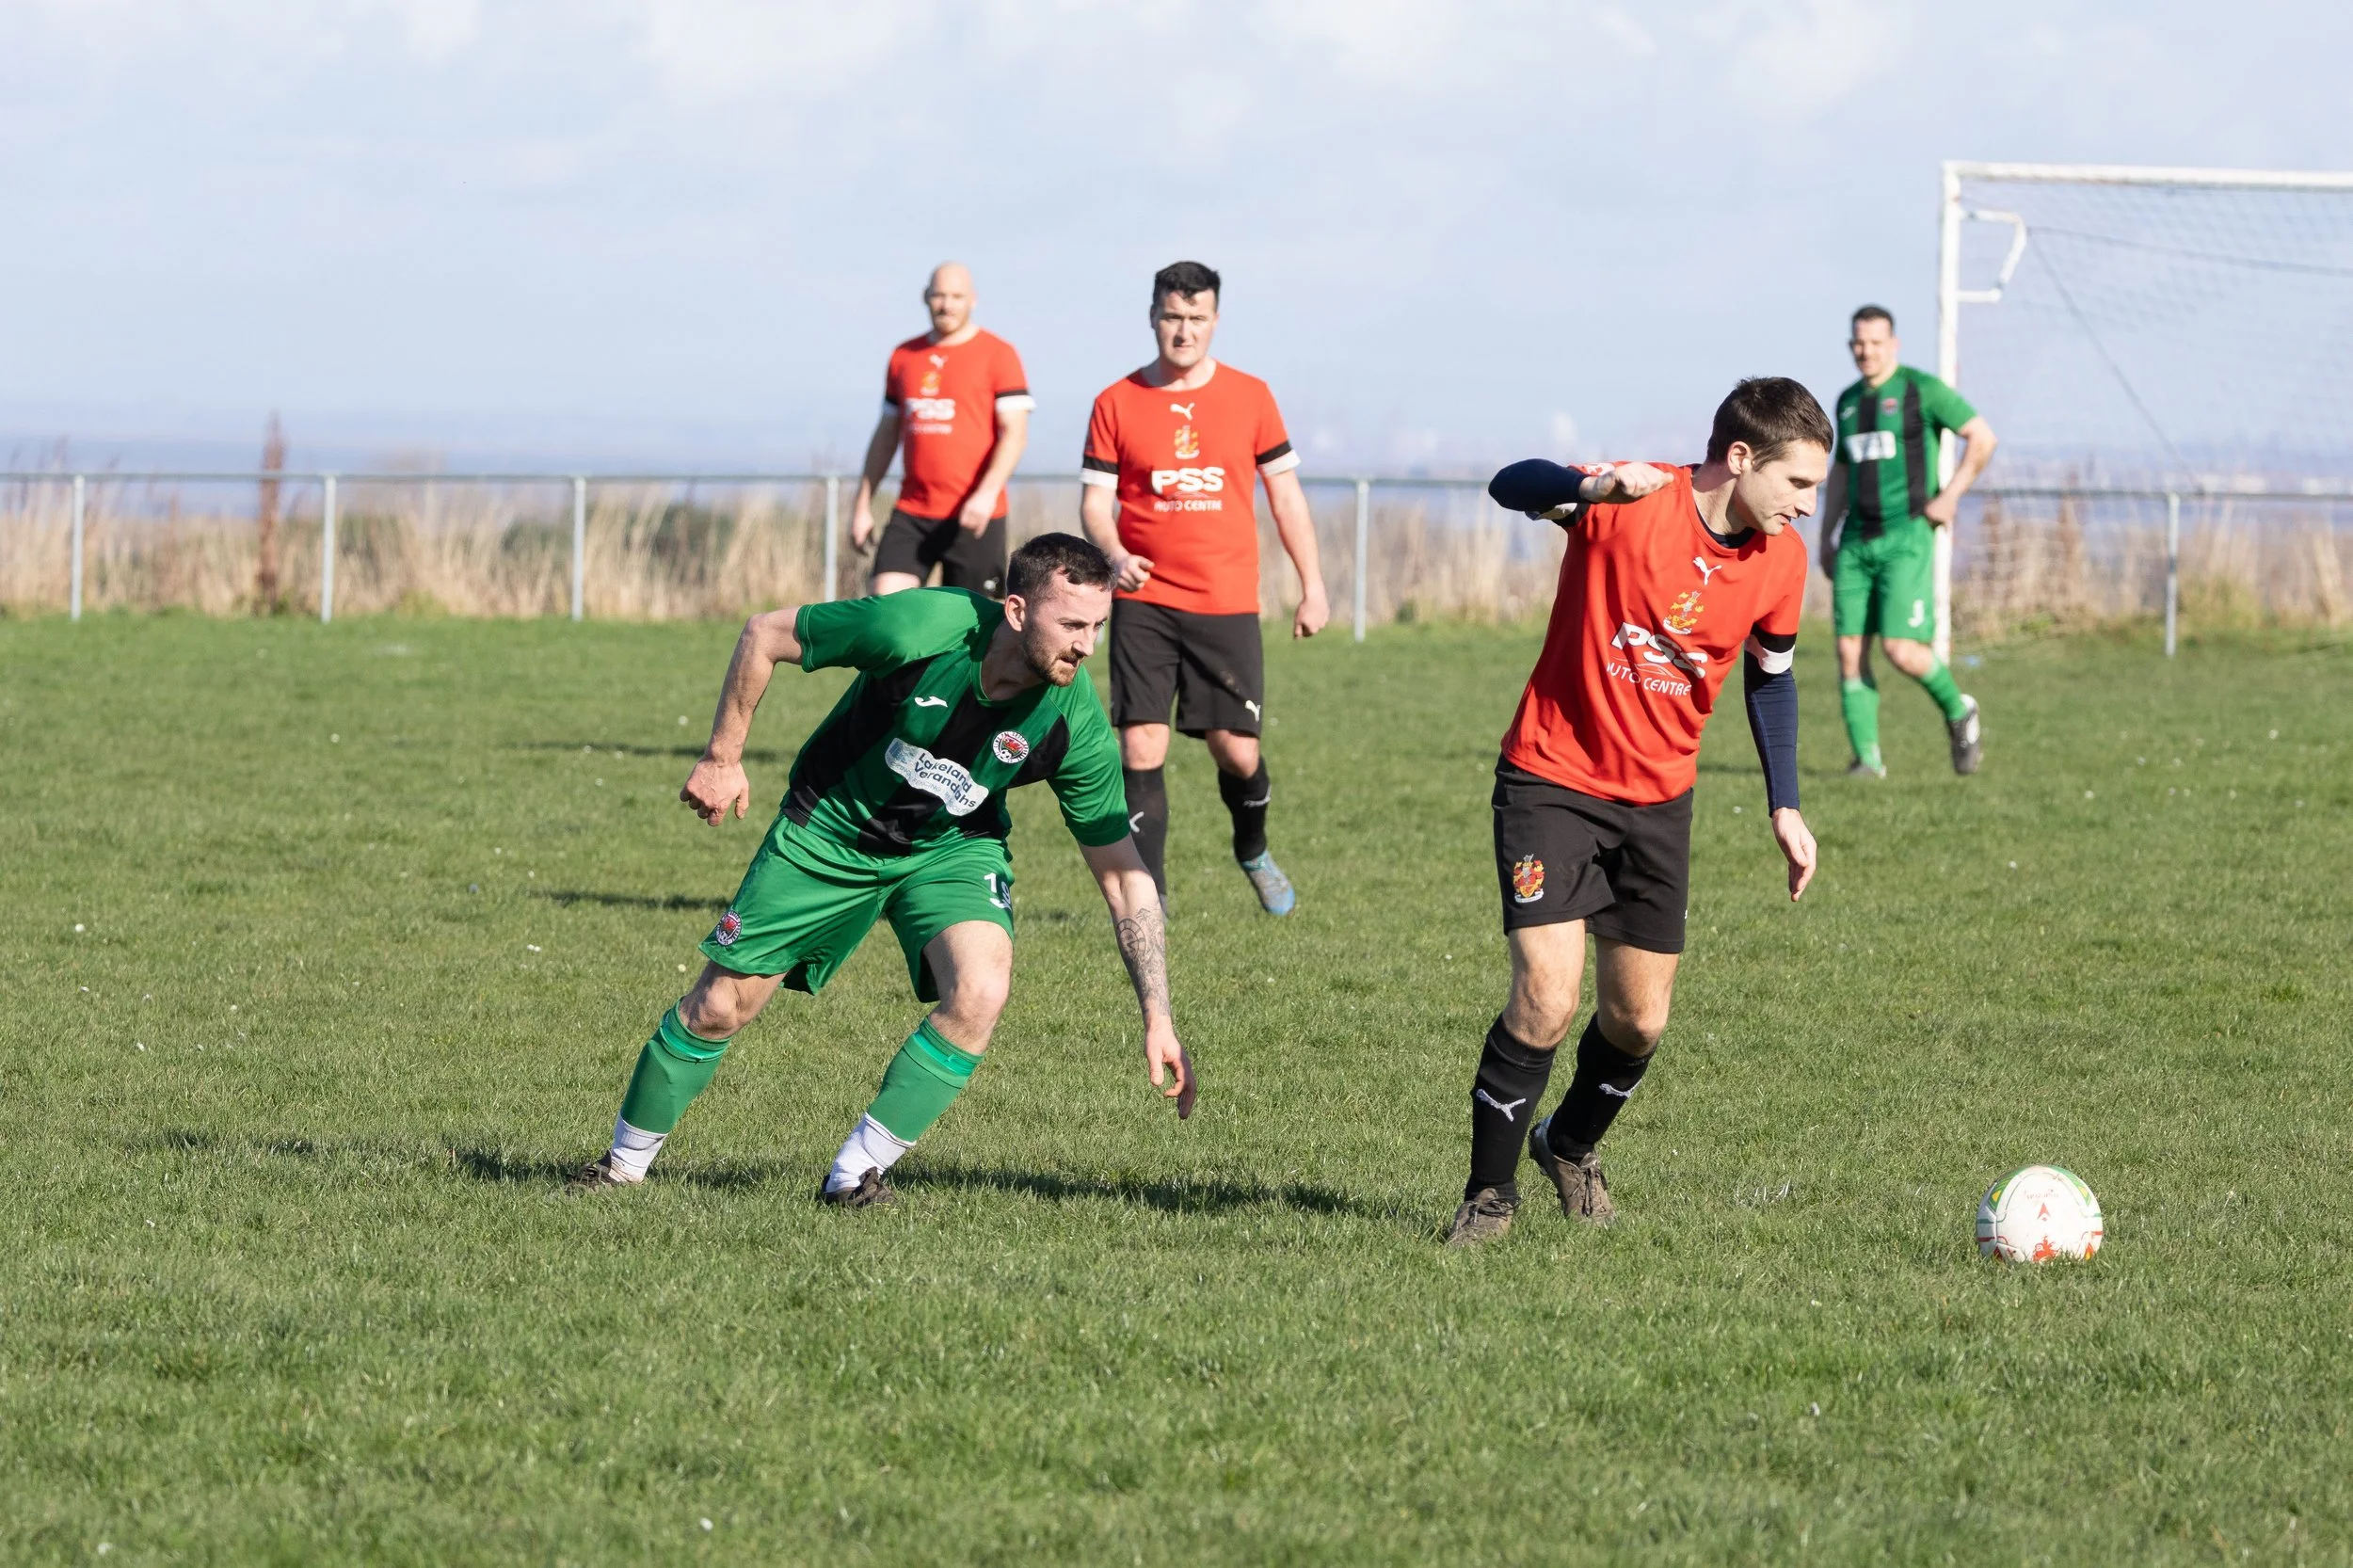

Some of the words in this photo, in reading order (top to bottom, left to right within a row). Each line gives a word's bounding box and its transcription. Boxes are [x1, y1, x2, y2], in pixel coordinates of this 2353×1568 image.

[1151, 466, 1225, 495] PSS
[1154, 500, 1183, 513] AUTO
[1184, 499, 1223, 512] CENTRE
[1611, 622, 1708, 679] PSS
[1643, 677, 1692, 696] CENTRE
[914, 761, 977, 808] Verandahs
[919, 752, 972, 792] Lakeland
